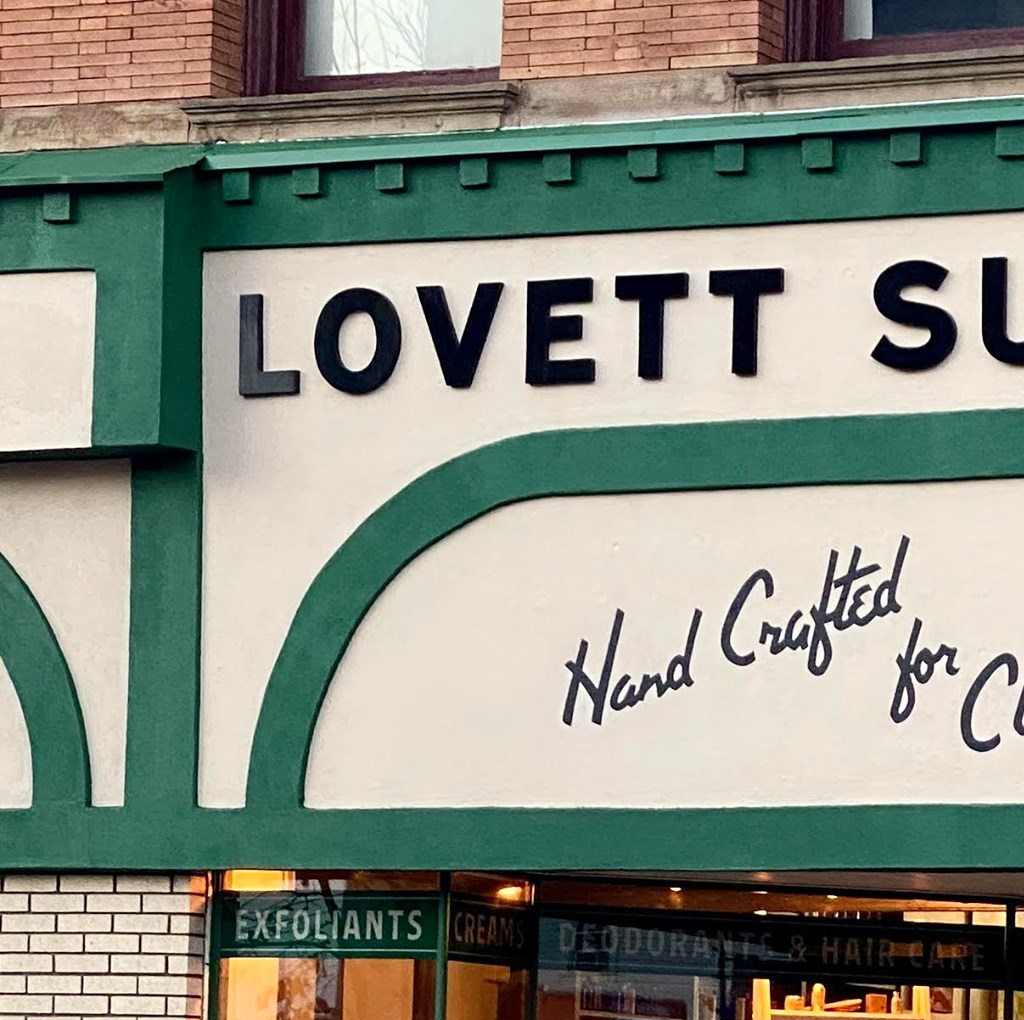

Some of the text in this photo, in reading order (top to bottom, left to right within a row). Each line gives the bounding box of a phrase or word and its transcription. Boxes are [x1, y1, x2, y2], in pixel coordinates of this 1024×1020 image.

[239, 267, 785, 397] LOVETT
[563, 609, 702, 725] Hand
[721, 535, 910, 676] Crafted
[891, 618, 959, 724] for
[235, 909, 423, 941] EXFOLIANTS
[454, 911, 525, 948] CREAMS
[790, 935, 808, 963] &
[821, 937, 894, 968] HAIR
[908, 940, 986, 972] CARE
